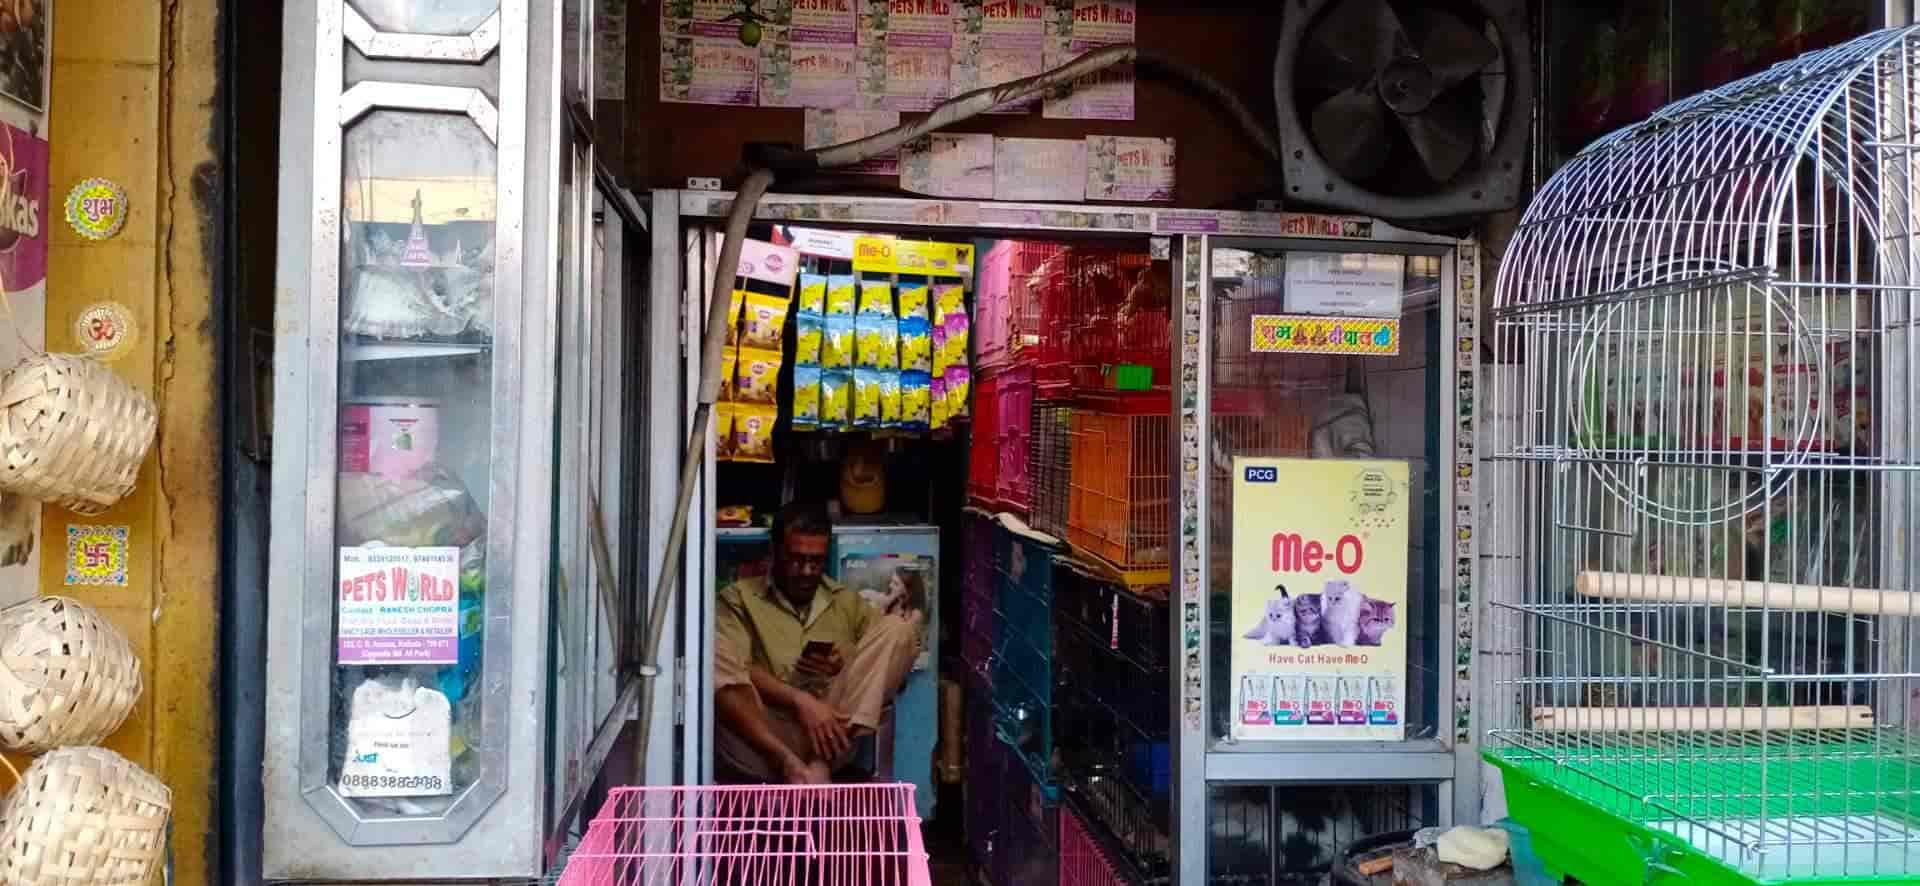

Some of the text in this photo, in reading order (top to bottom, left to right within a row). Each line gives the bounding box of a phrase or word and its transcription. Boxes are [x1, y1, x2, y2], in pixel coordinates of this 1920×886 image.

[889, 0, 949, 15] PETS WRLD
[984, 1, 1041, 18] PETS WRLD
[1074, 3, 1133, 24] PETS WRLD
[83, 198, 114, 221] शुभ
[1305, 214, 1340, 236] WRLD
[1248, 469, 1275, 481] PCG
[1271, 532, 1363, 574] Me-O
[342, 569, 387, 602] PETS
[1269, 654, 1295, 665] Have
[1297, 654, 1316, 665] Cat
[1318, 654, 1344, 665] Have
